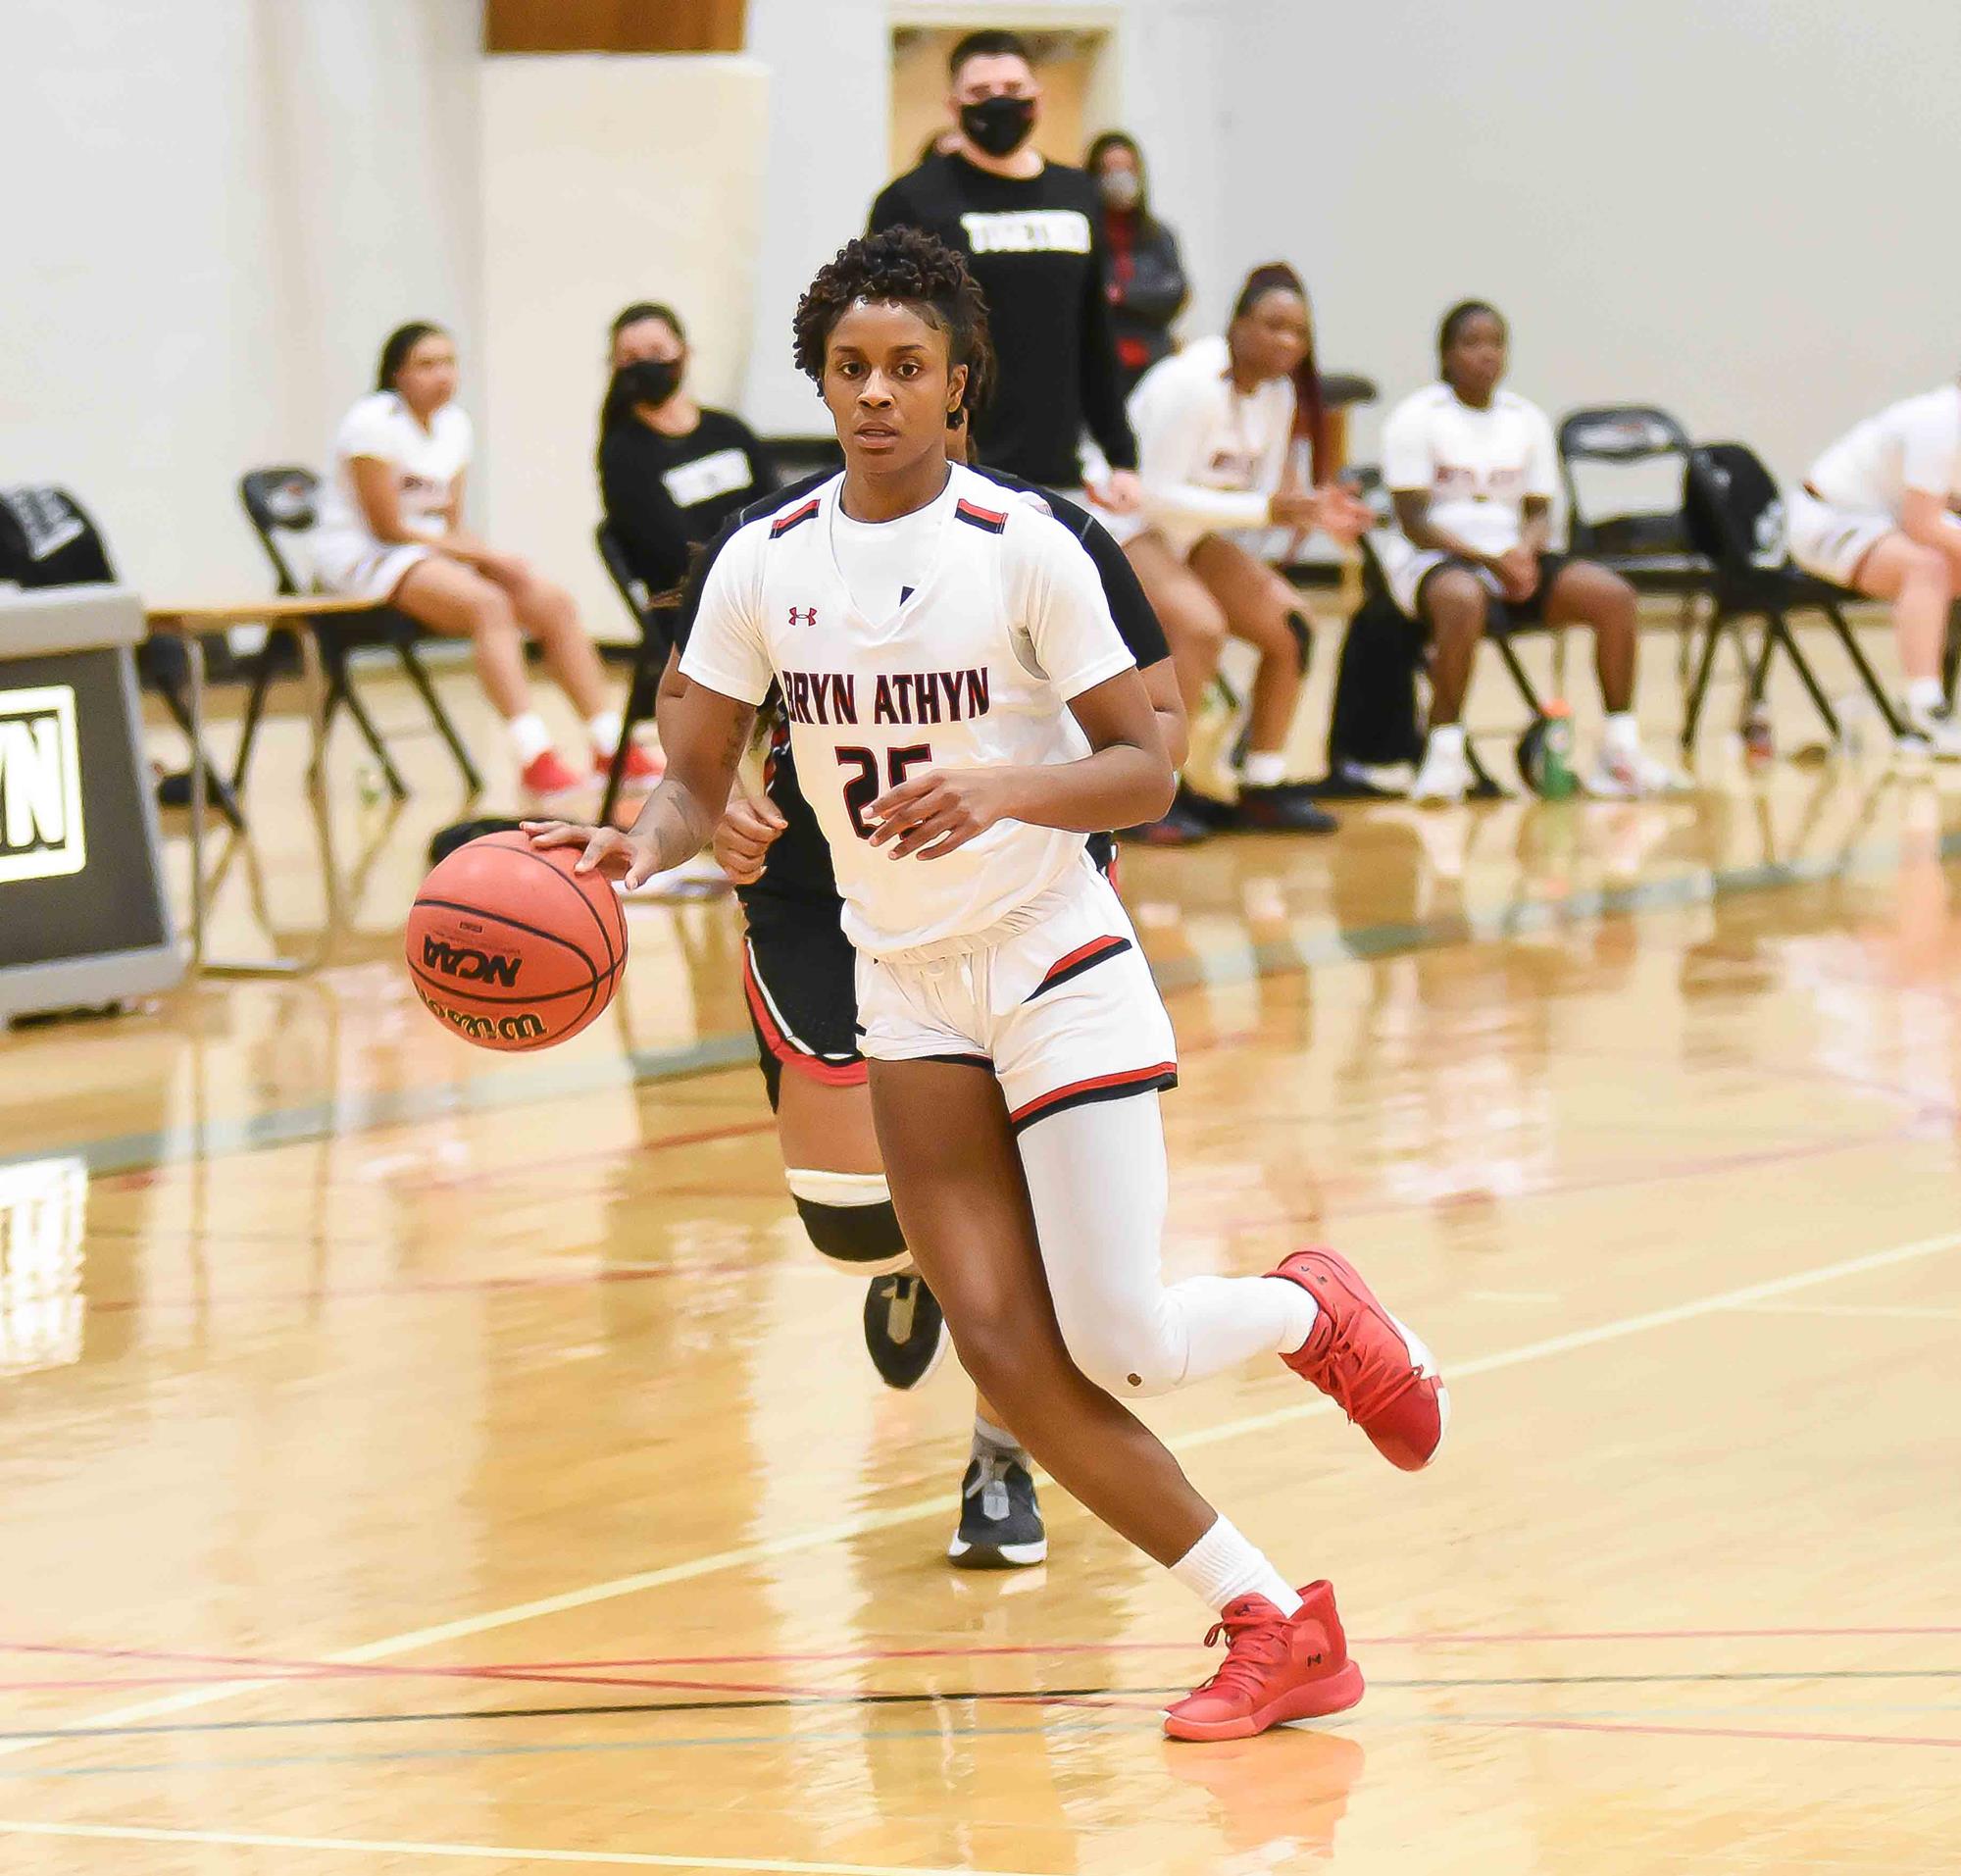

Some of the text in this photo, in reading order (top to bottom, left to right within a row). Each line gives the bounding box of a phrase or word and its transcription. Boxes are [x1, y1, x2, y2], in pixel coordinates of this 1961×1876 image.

[781, 667, 990, 725] BRYN ATHYN
[423, 934, 523, 988] NCAA
